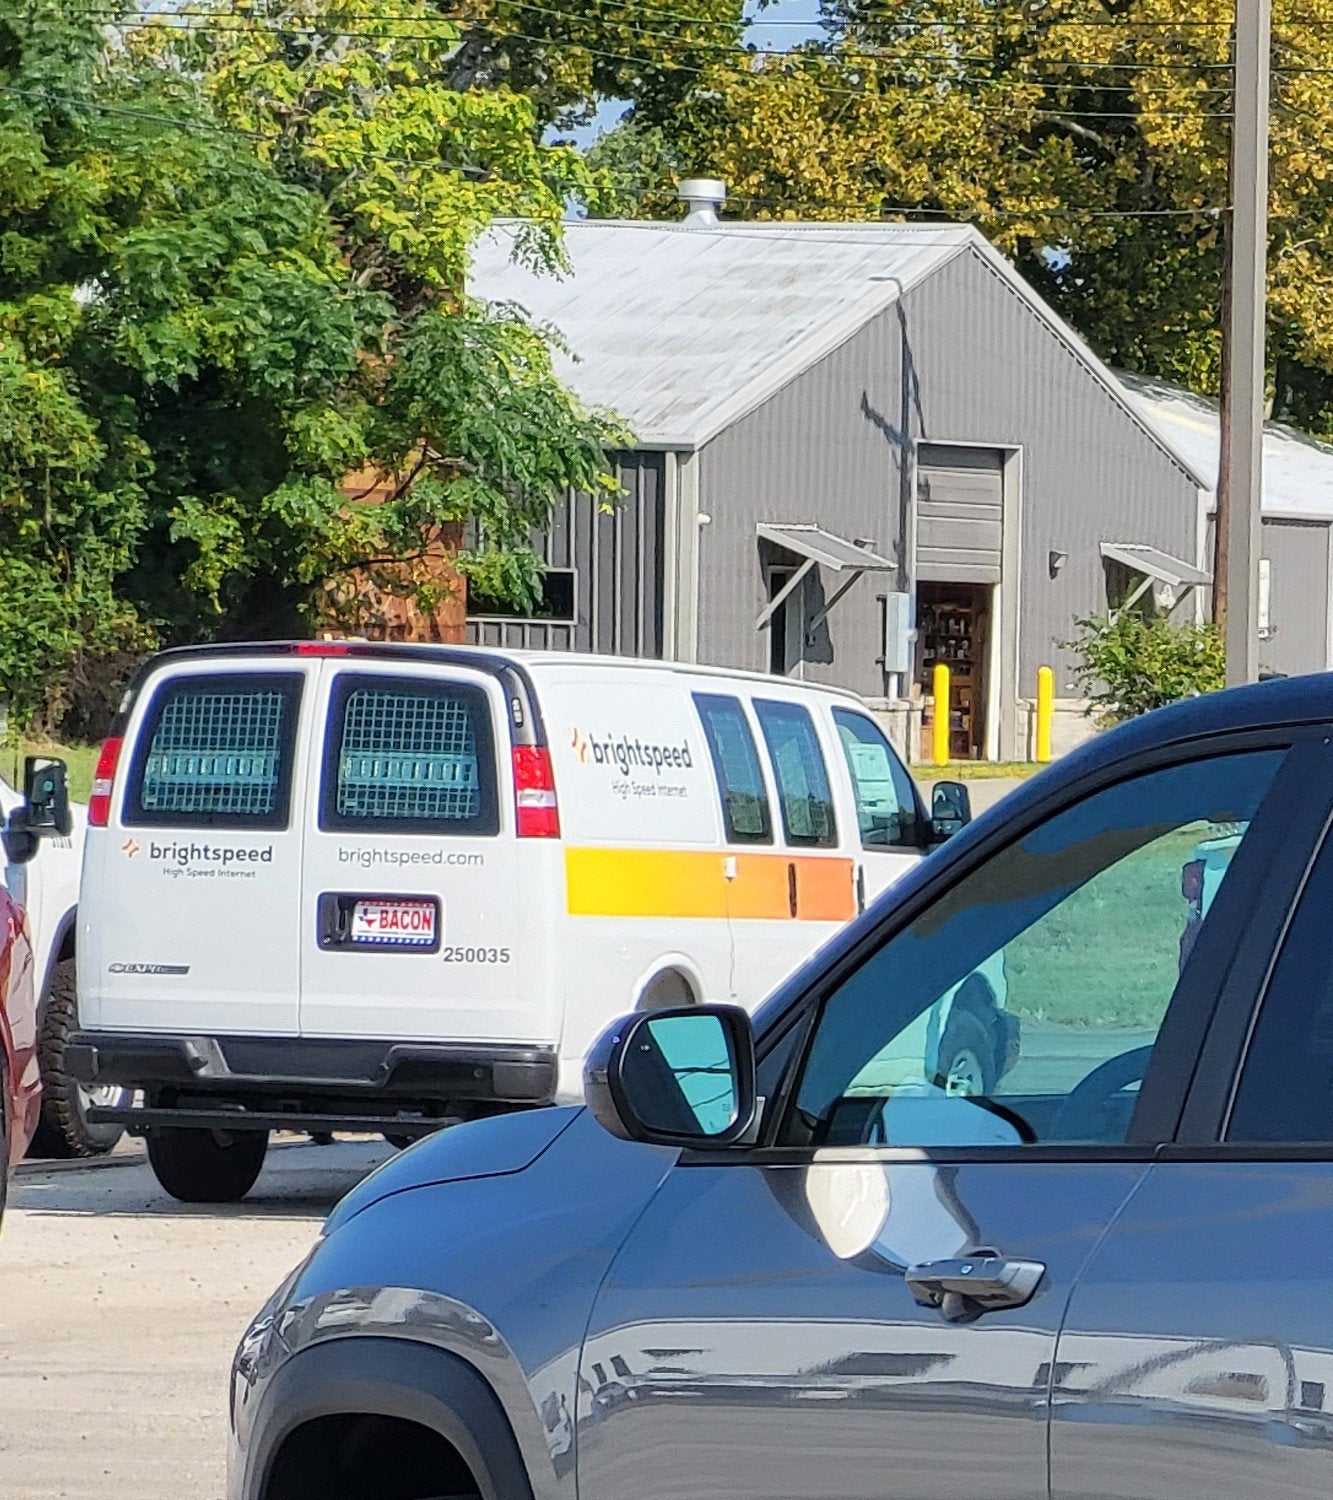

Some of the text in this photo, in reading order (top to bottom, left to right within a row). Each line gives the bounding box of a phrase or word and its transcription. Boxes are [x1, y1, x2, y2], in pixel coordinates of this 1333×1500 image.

[589, 732, 693, 776] brightspeed
[150, 842, 273, 866] brightspeed
[338, 847, 485, 868] brightspeed.com
[163, 867, 184, 879] High
[186, 868, 216, 879] Speed
[379, 909, 433, 931] BACON
[443, 947, 511, 964] 250035
